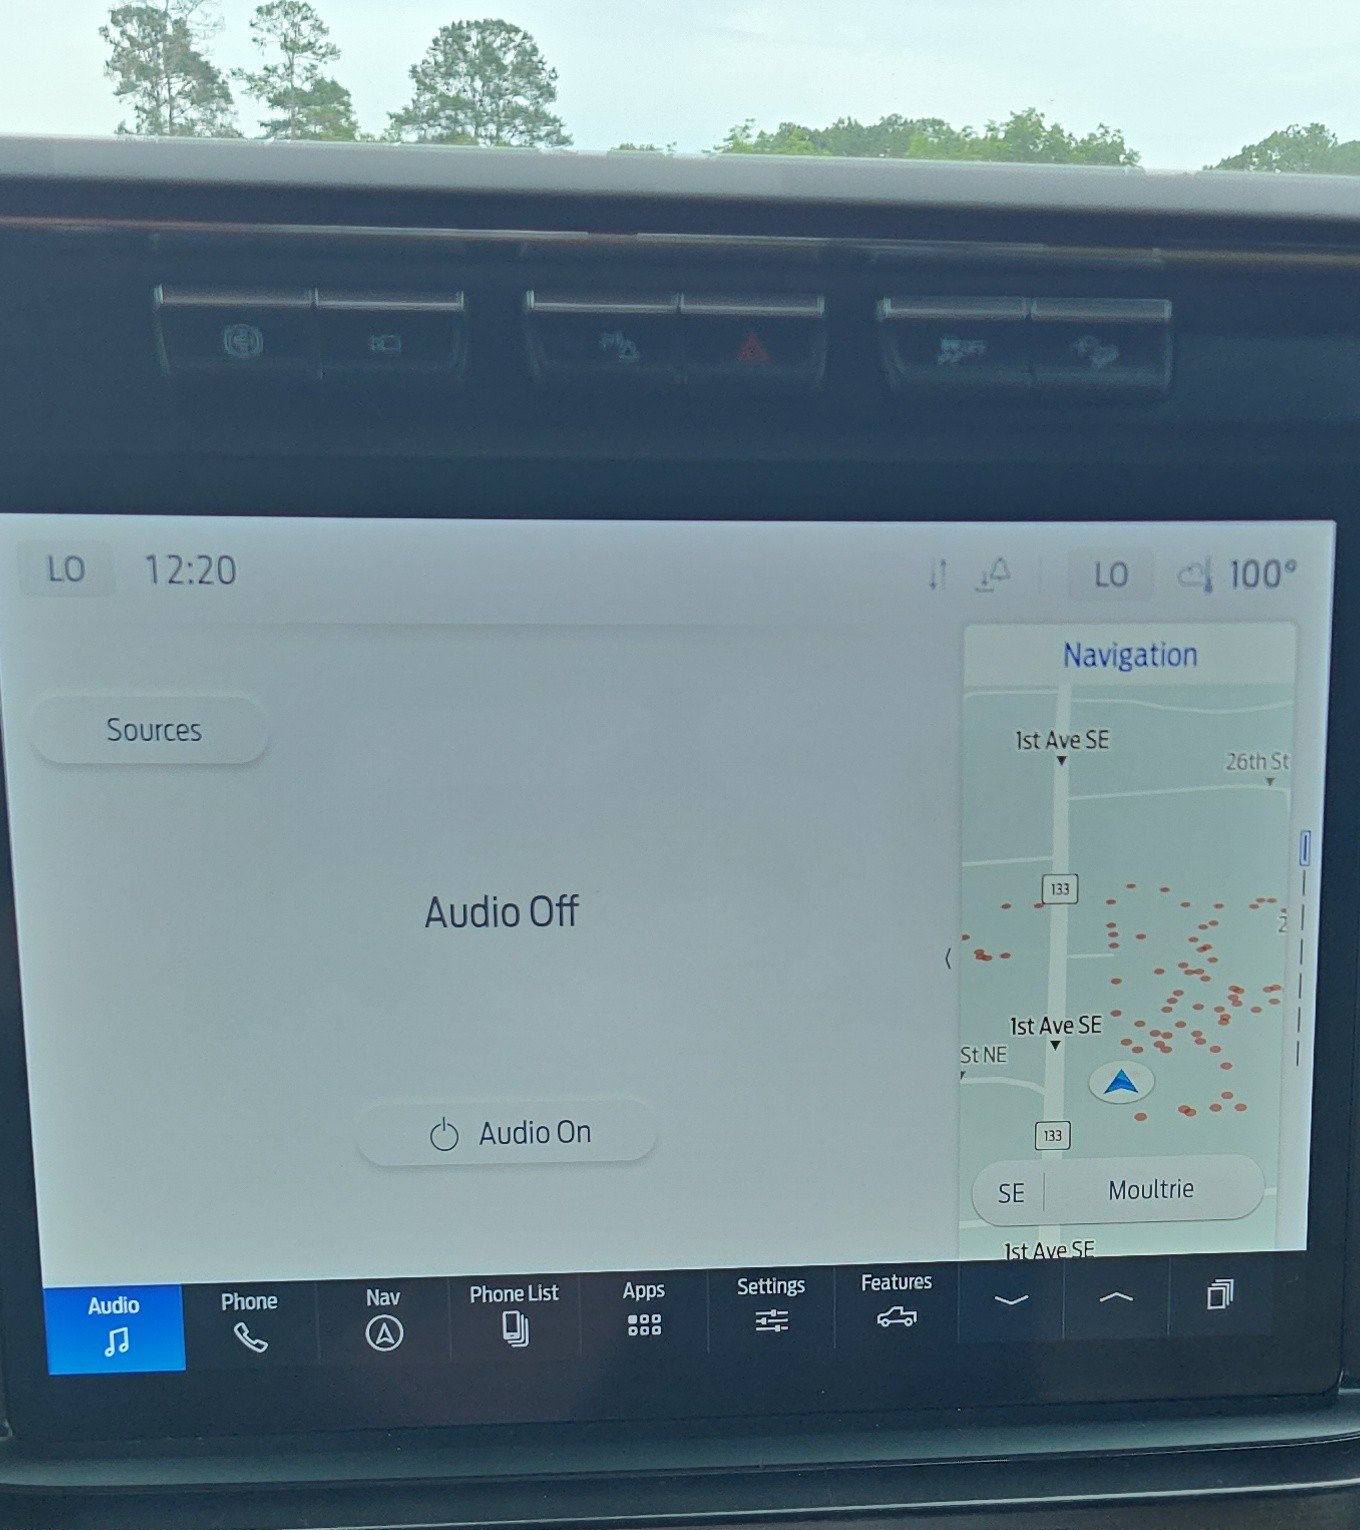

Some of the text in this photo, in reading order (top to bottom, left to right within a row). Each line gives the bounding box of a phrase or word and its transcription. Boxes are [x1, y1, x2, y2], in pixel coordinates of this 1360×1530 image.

[46, 553, 86, 584] LO
[144, 553, 237, 586] 12:20
[1094, 561, 1129, 588] LO
[1230, 558, 1299, 589] 100°
[1063, 641, 1198, 672] Navigation
[106, 717, 203, 744] Sources
[1015, 729, 1109, 750] 1st Ave SE
[1226, 752, 1290, 771] 26th St
[1050, 882, 1070, 896] 133
[424, 892, 581, 929] Audio Off
[1010, 1015, 1103, 1036] 1st Ave SE
[960, 1046, 1007, 1064] St NE
[479, 1119, 592, 1146] Audio On
[1043, 1129, 1062, 1143] 133
[998, 1183, 1025, 1204] SE
[1108, 1178, 1195, 1201] Moultrie
[1005, 1240, 1095, 1260] 1st Ave SE
[622, 1281, 666, 1301] Apps
[737, 1276, 806, 1298] Settings
[861, 1273, 933, 1292] Features
[221, 1292, 278, 1312] Phone
[365, 1288, 401, 1308] Nav
[470, 1283, 559, 1304] Phone List
[87, 1296, 141, 1316] Audio
